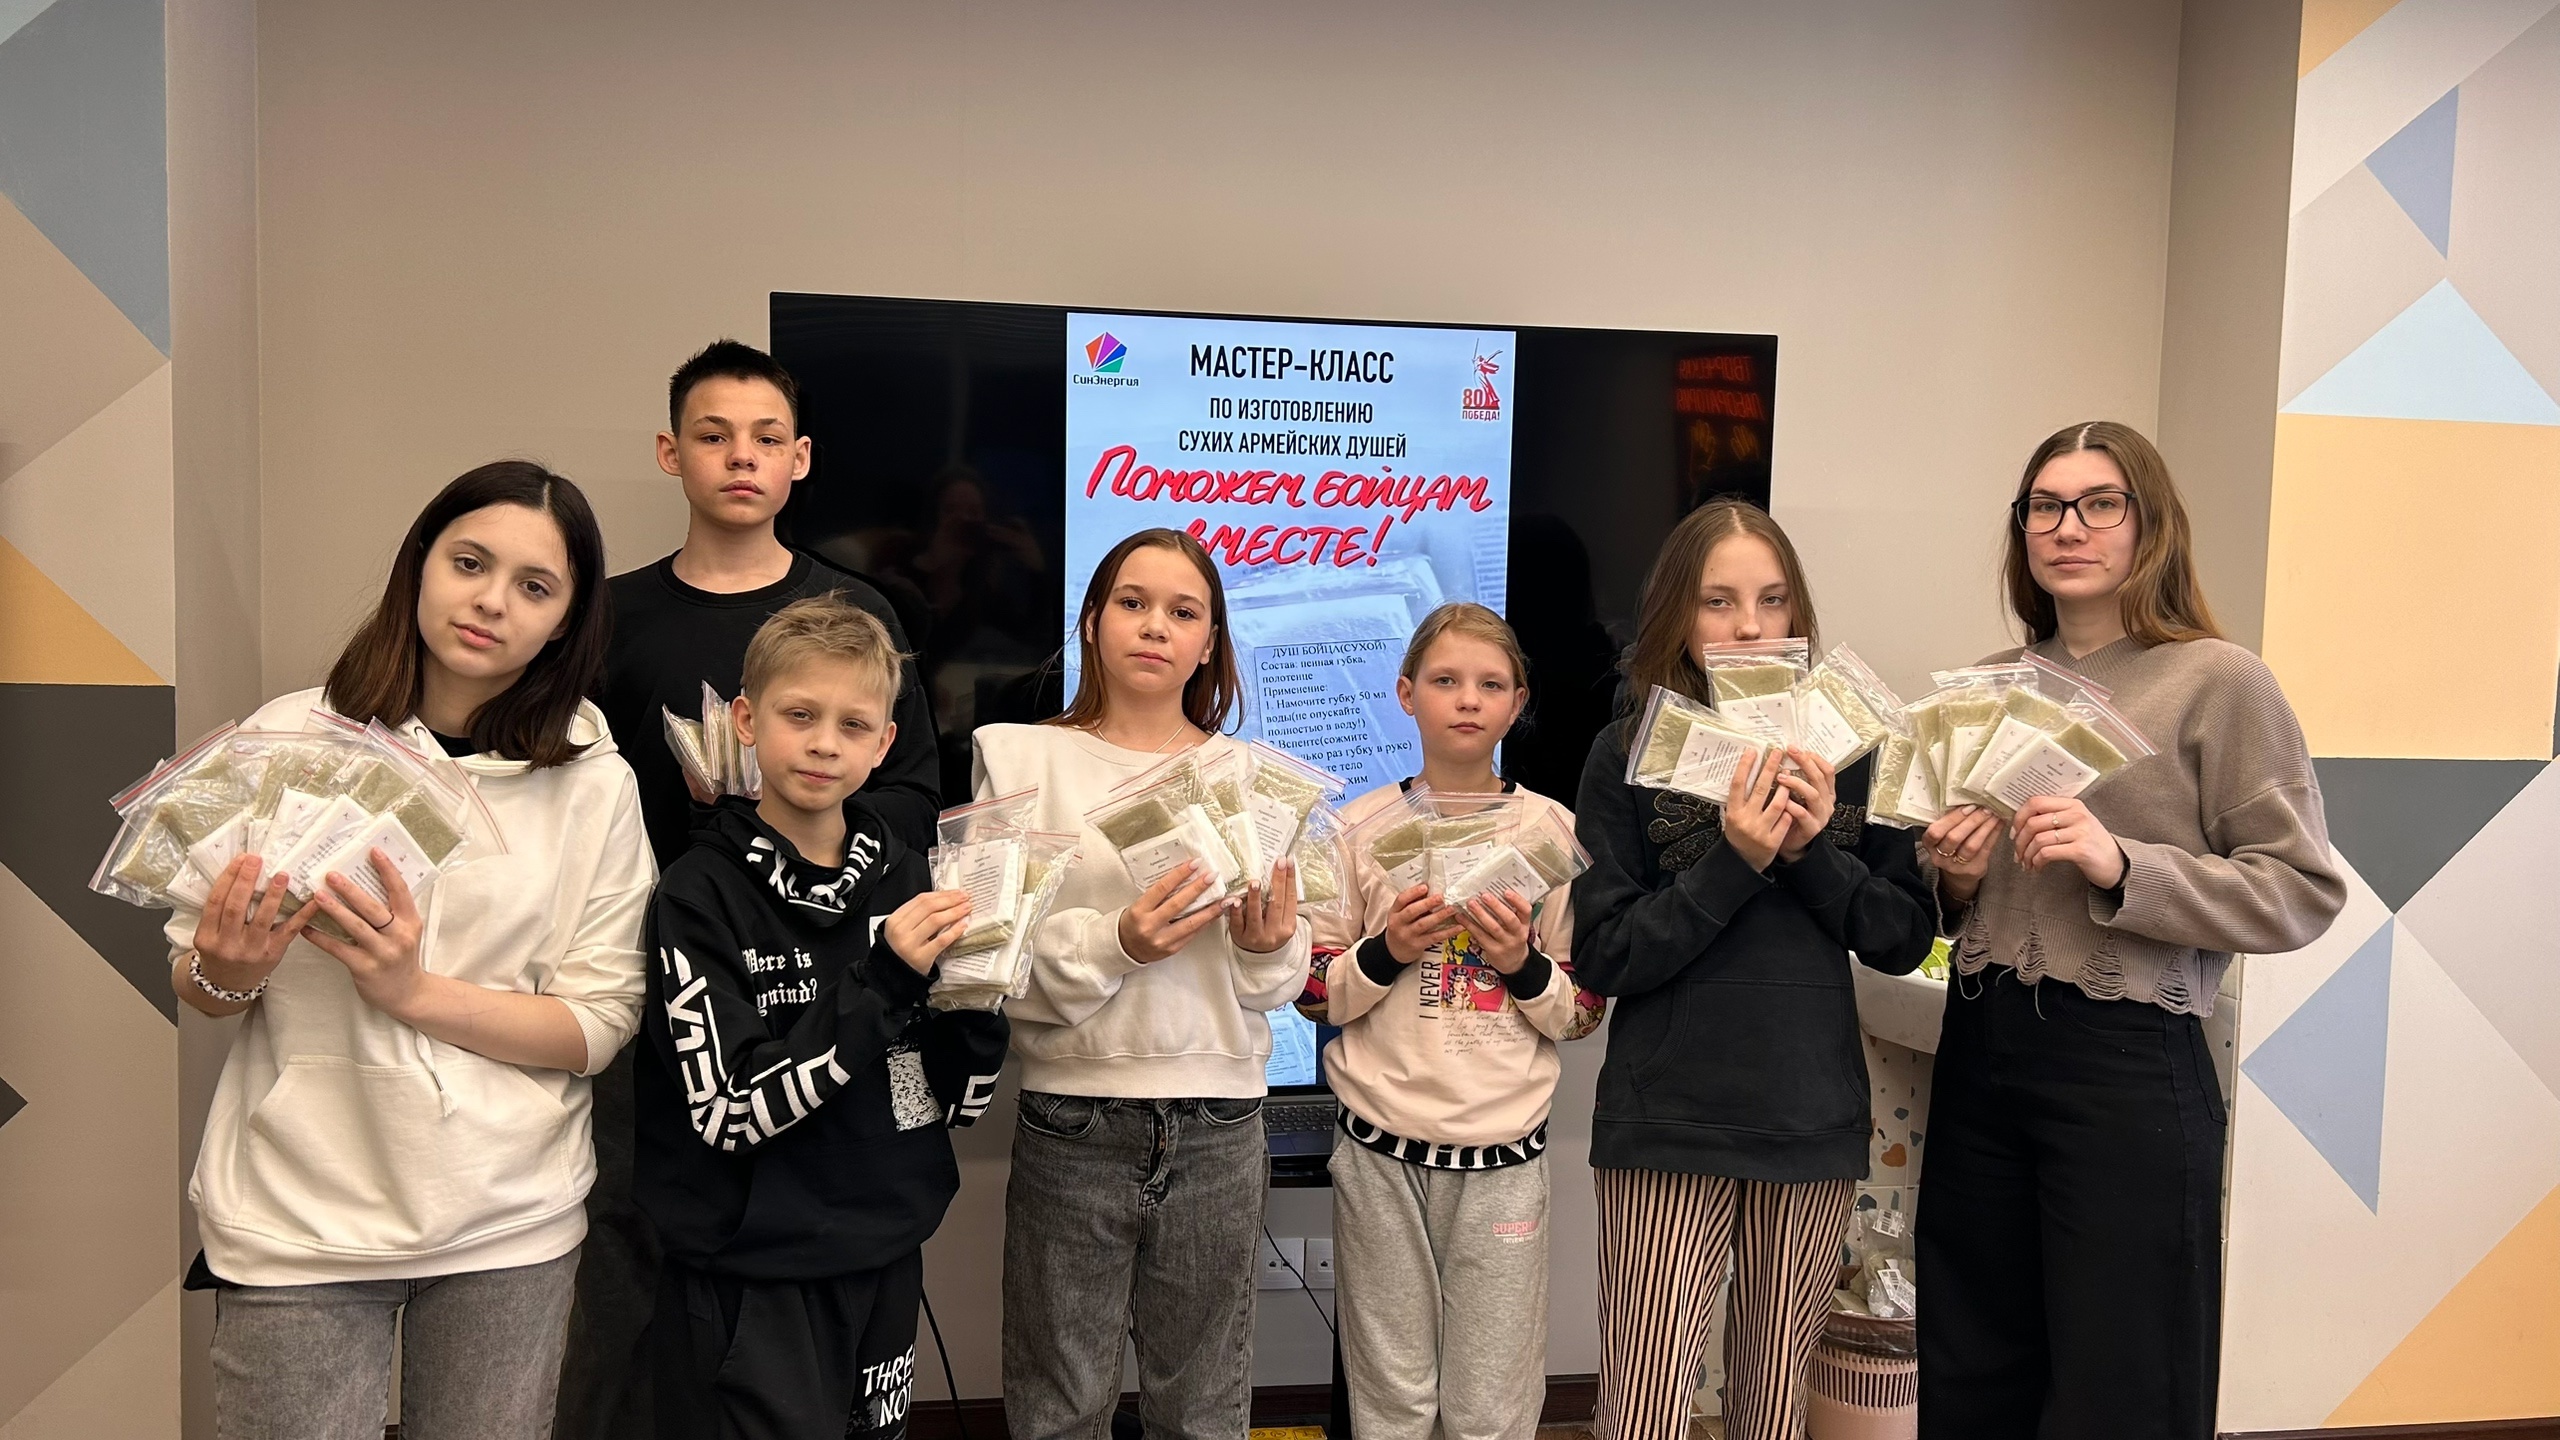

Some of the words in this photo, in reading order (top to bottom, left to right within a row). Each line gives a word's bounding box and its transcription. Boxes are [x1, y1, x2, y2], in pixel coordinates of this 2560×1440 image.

[1190, 343, 1395, 384] МАСТЕР-КЛАСС
[1073, 373, 1139, 387] СинЭнергия
[1463, 388, 1483, 407] 80
[1209, 397, 1232, 420] ПО
[1238, 398, 1373, 424] ИЗГОТОВЛЕНИЮ
[1462, 410, 1500, 421] ПОБЕДА!
[1179, 430, 1234, 453] СУХИХ
[1238, 429, 1341, 457] АРМЕЙСКИХ
[1345, 432, 1407, 459] ДУШЕЙ
[1272, 647, 1299, 659] ДУШ
[1261, 660, 1298, 671] Состав:
[1301, 658, 1334, 669] пенная
[1336, 655, 1366, 667] губка,
[1262, 672, 1313, 684] полотенце
[1263, 684, 1328, 698] Применение:
[1277, 697, 1326, 710] Намочите
[1328, 693, 1356, 707] губку
[1359, 690, 1371, 700] 50
[1373, 691, 1387, 699] мл
[1309, 706, 1361, 722] опускайте
[1268, 724, 1324, 737] полностью
[1326, 750, 1343, 761] раз
[1346, 744, 1374, 758] губку
[1386, 740, 1412, 755] руке)
[1339, 761, 1363, 771] тело
[793, 947, 813, 969] is
[1419, 961, 1442, 1007] NEVER
